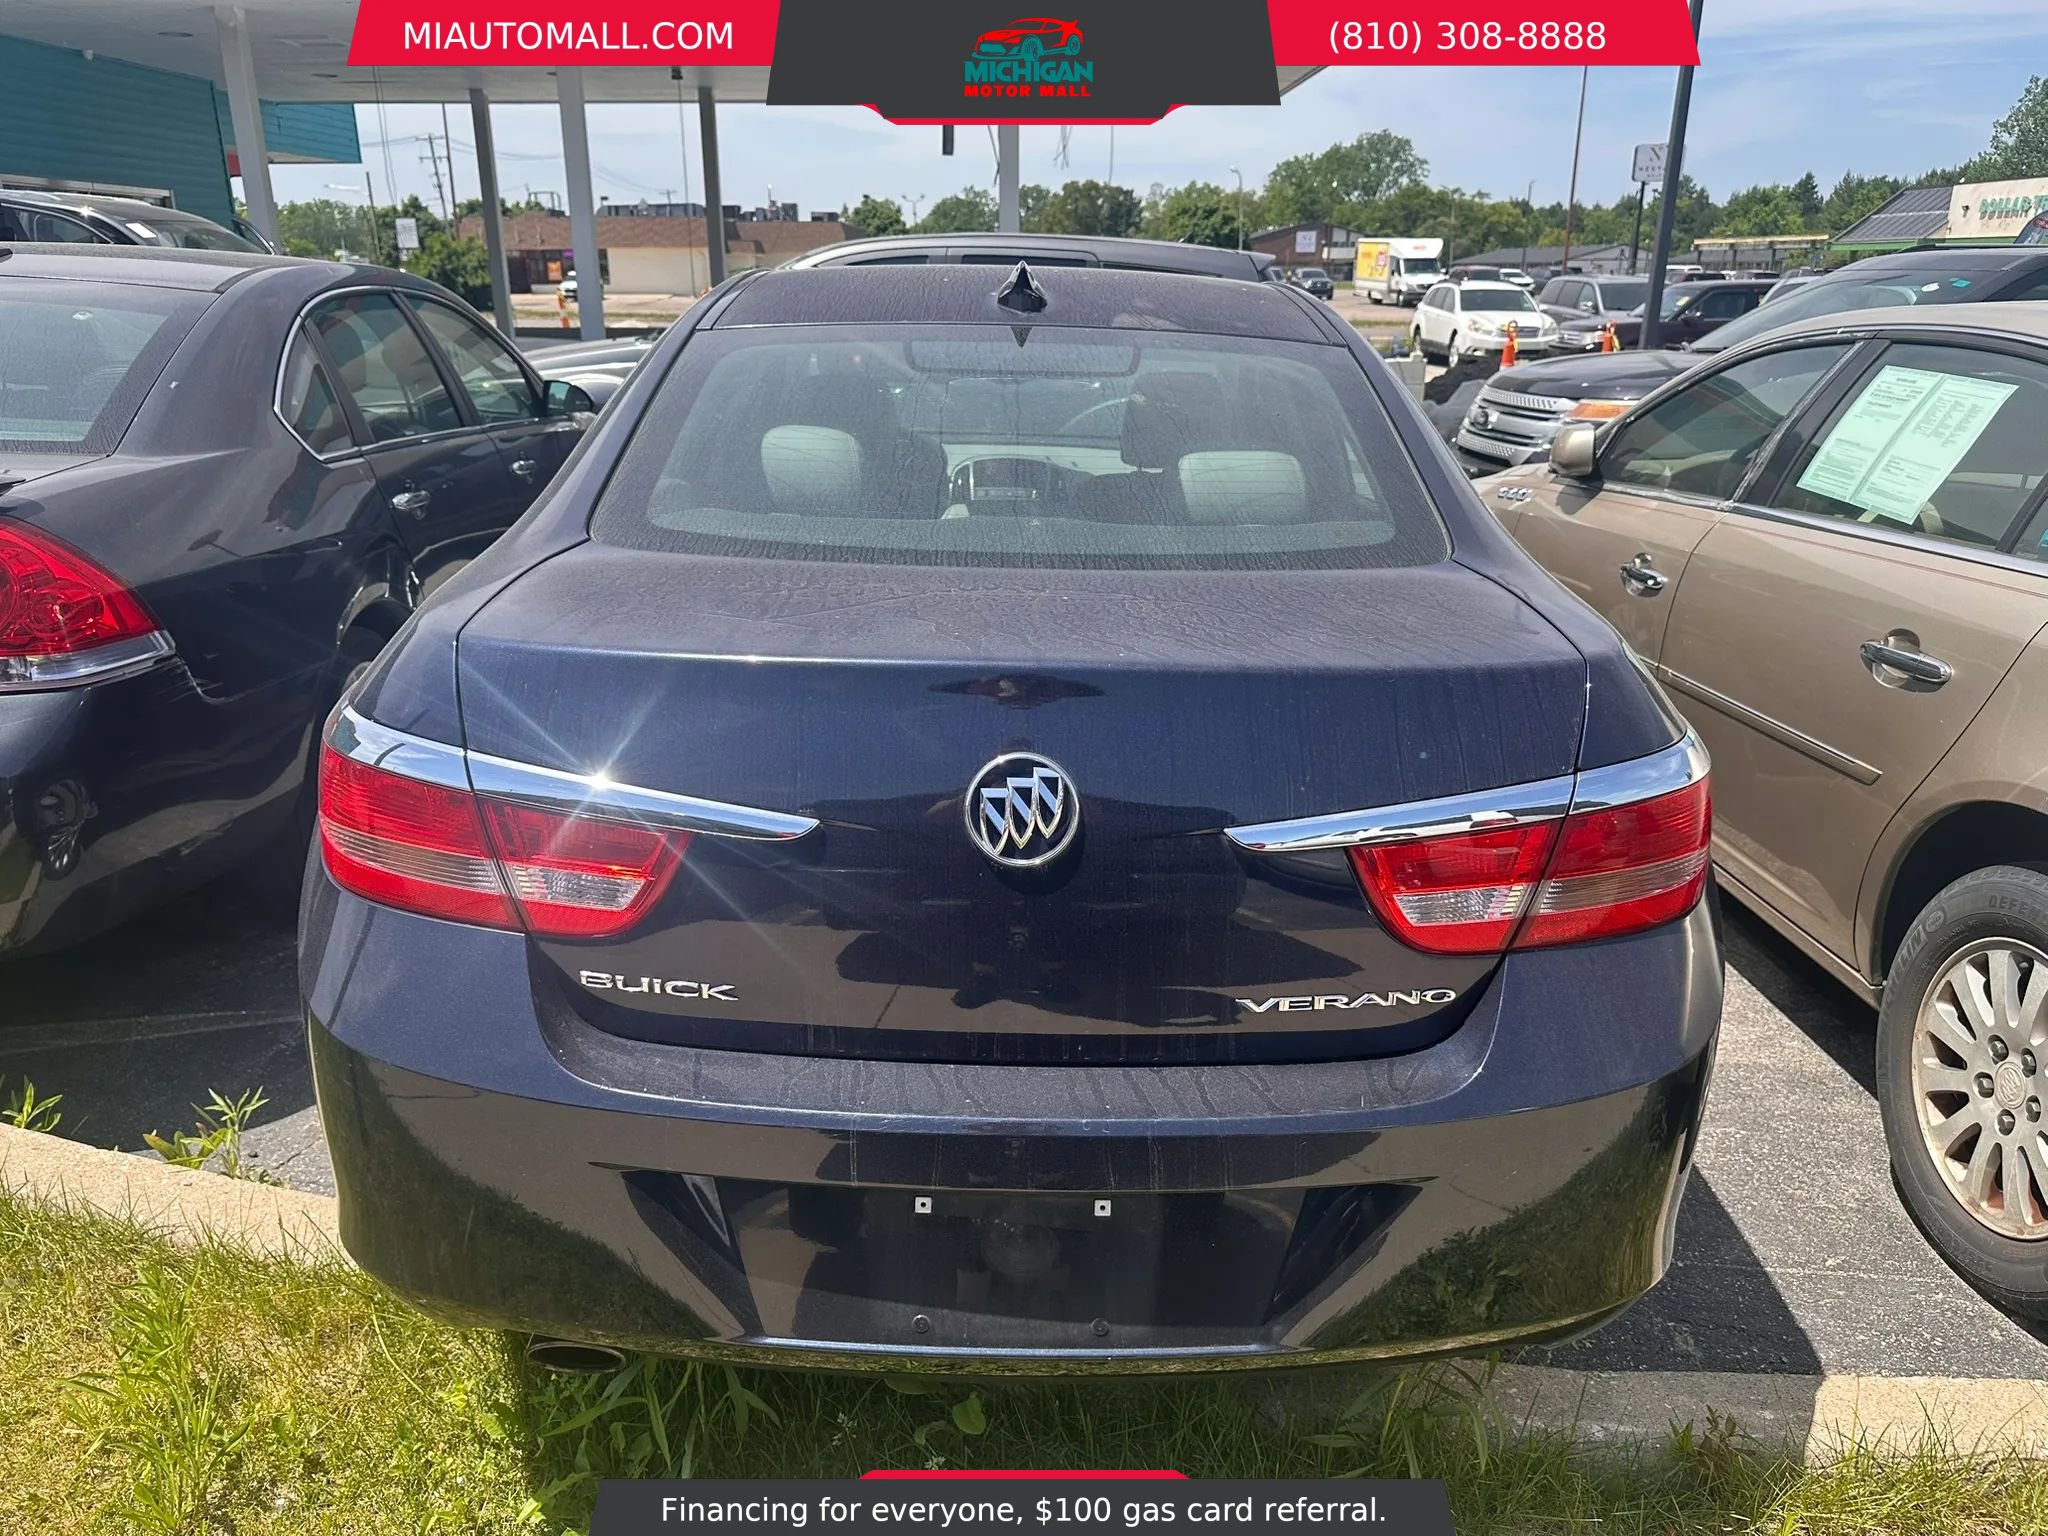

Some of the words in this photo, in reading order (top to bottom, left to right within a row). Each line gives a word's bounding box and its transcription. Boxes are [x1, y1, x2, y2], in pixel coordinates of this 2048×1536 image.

[1979, 196, 2031, 213] DOLLAR
[579, 969, 739, 1001] BUICK
[1235, 989, 1456, 1013] VERANO
